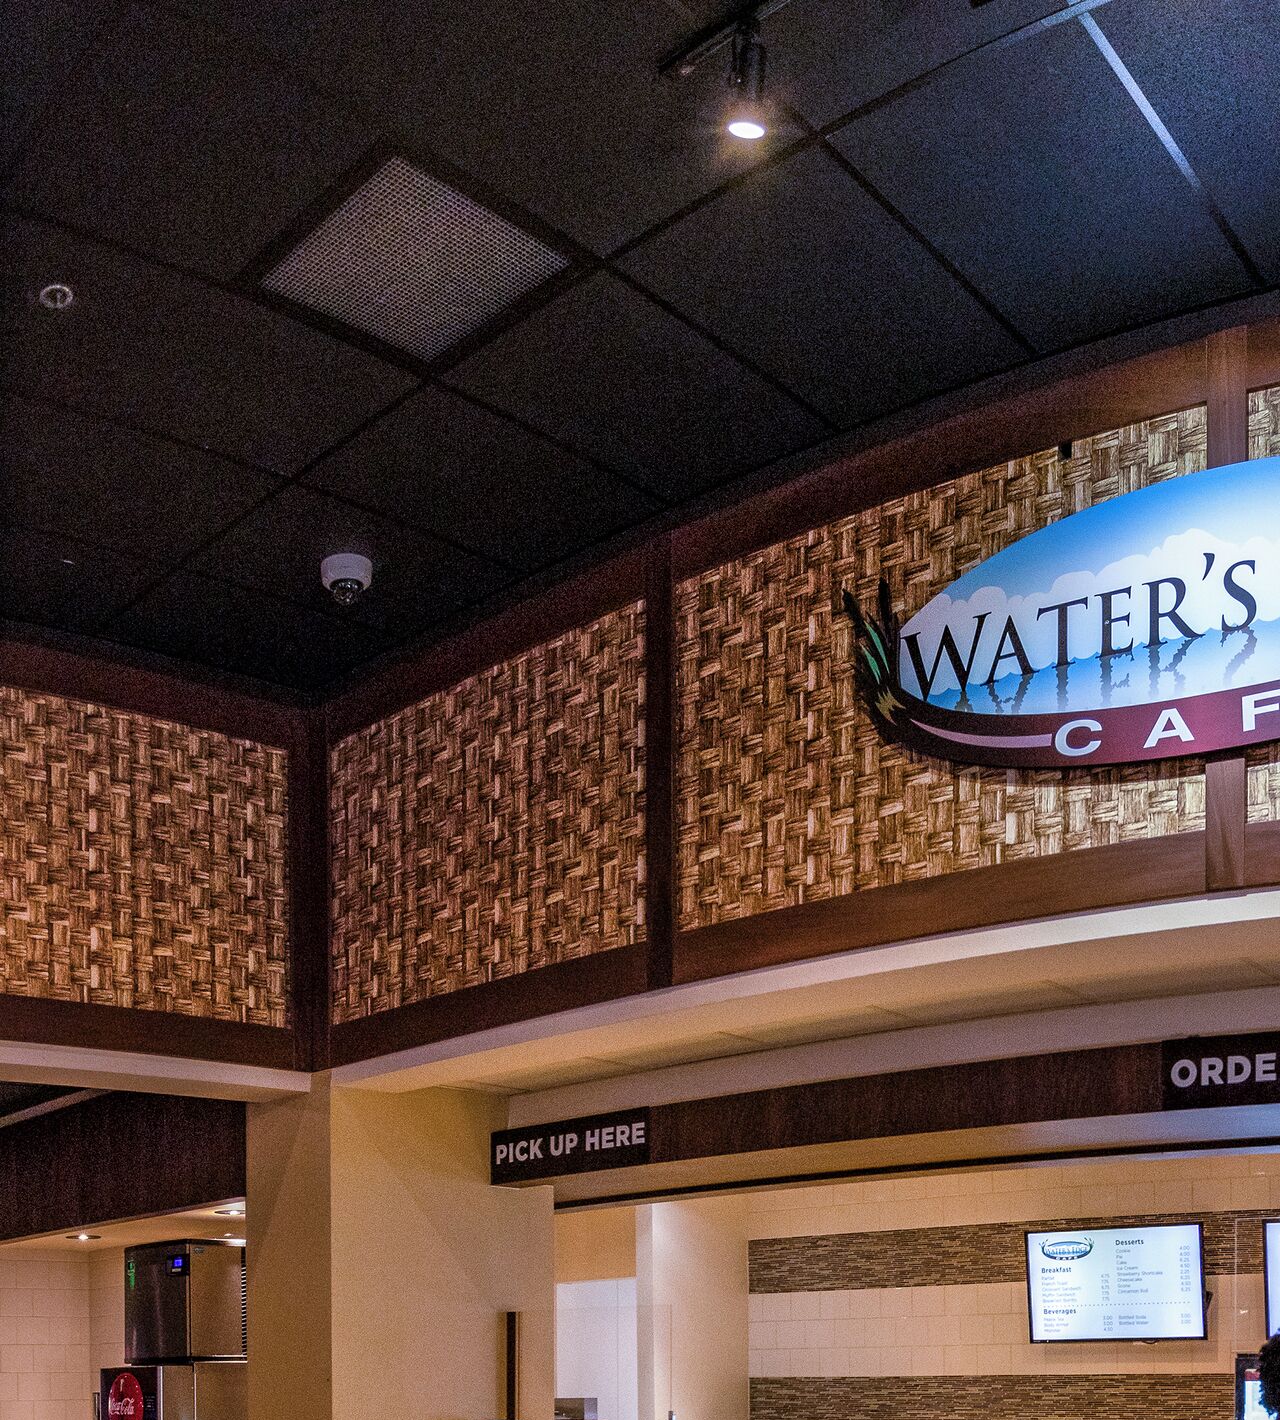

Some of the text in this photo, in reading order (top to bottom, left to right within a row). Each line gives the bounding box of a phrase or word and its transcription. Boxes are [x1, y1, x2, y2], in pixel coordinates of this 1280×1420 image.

[900, 552, 1257, 701] WATER'S
[496, 1122, 646, 1165] PICK UP HERE
[1043, 1308, 1077, 1316] Beverages
